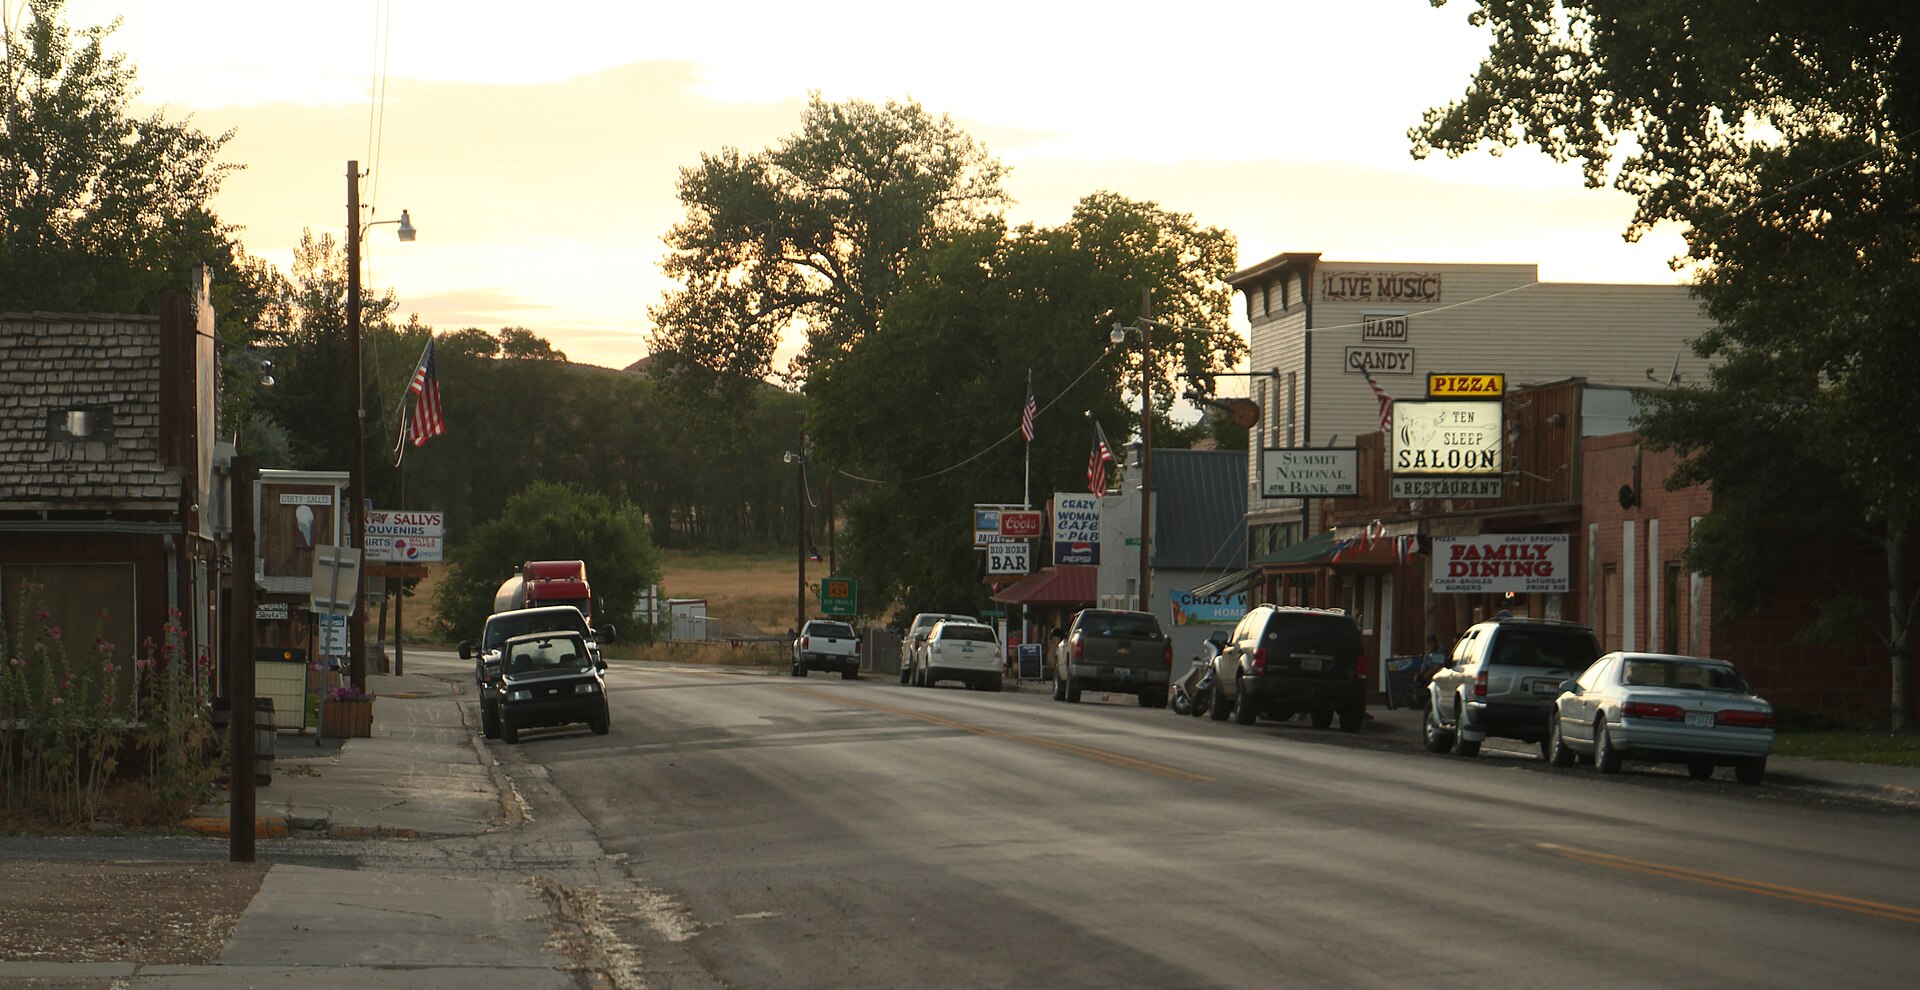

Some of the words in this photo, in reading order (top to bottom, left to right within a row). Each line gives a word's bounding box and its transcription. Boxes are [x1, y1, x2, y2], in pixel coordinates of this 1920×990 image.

[1328, 276, 1372, 296] LIVE
[1377, 277, 1436, 298] MUSIC
[1366, 319, 1404, 338] HARD
[1350, 351, 1410, 370] CANDY
[1433, 378, 1499, 392] PIZZA
[1452, 411, 1475, 423] TEN
[1443, 432, 1483, 446] SLEEP
[1282, 452, 1338, 465] SUMMIT
[1398, 450, 1496, 469] SALOON
[1276, 466, 1346, 480] NATIONAL
[1269, 484, 1284, 492] ATM
[1290, 482, 1329, 494] BANK
[1404, 481, 1500, 496] RESTAURANT
[306, 496, 330, 504] SALLYS
[1062, 500, 1096, 509] CRAZY
[394, 514, 440, 526] SALLYS
[1004, 516, 1036, 529] Coors
[1058, 511, 1099, 521] WOMAN
[1068, 532, 1099, 541] PUB
[1450, 544, 1553, 560] FAMILY
[992, 556, 1027, 570] BAR
[1448, 560, 1554, 577] DINING
[1214, 608, 1247, 616] HOME
